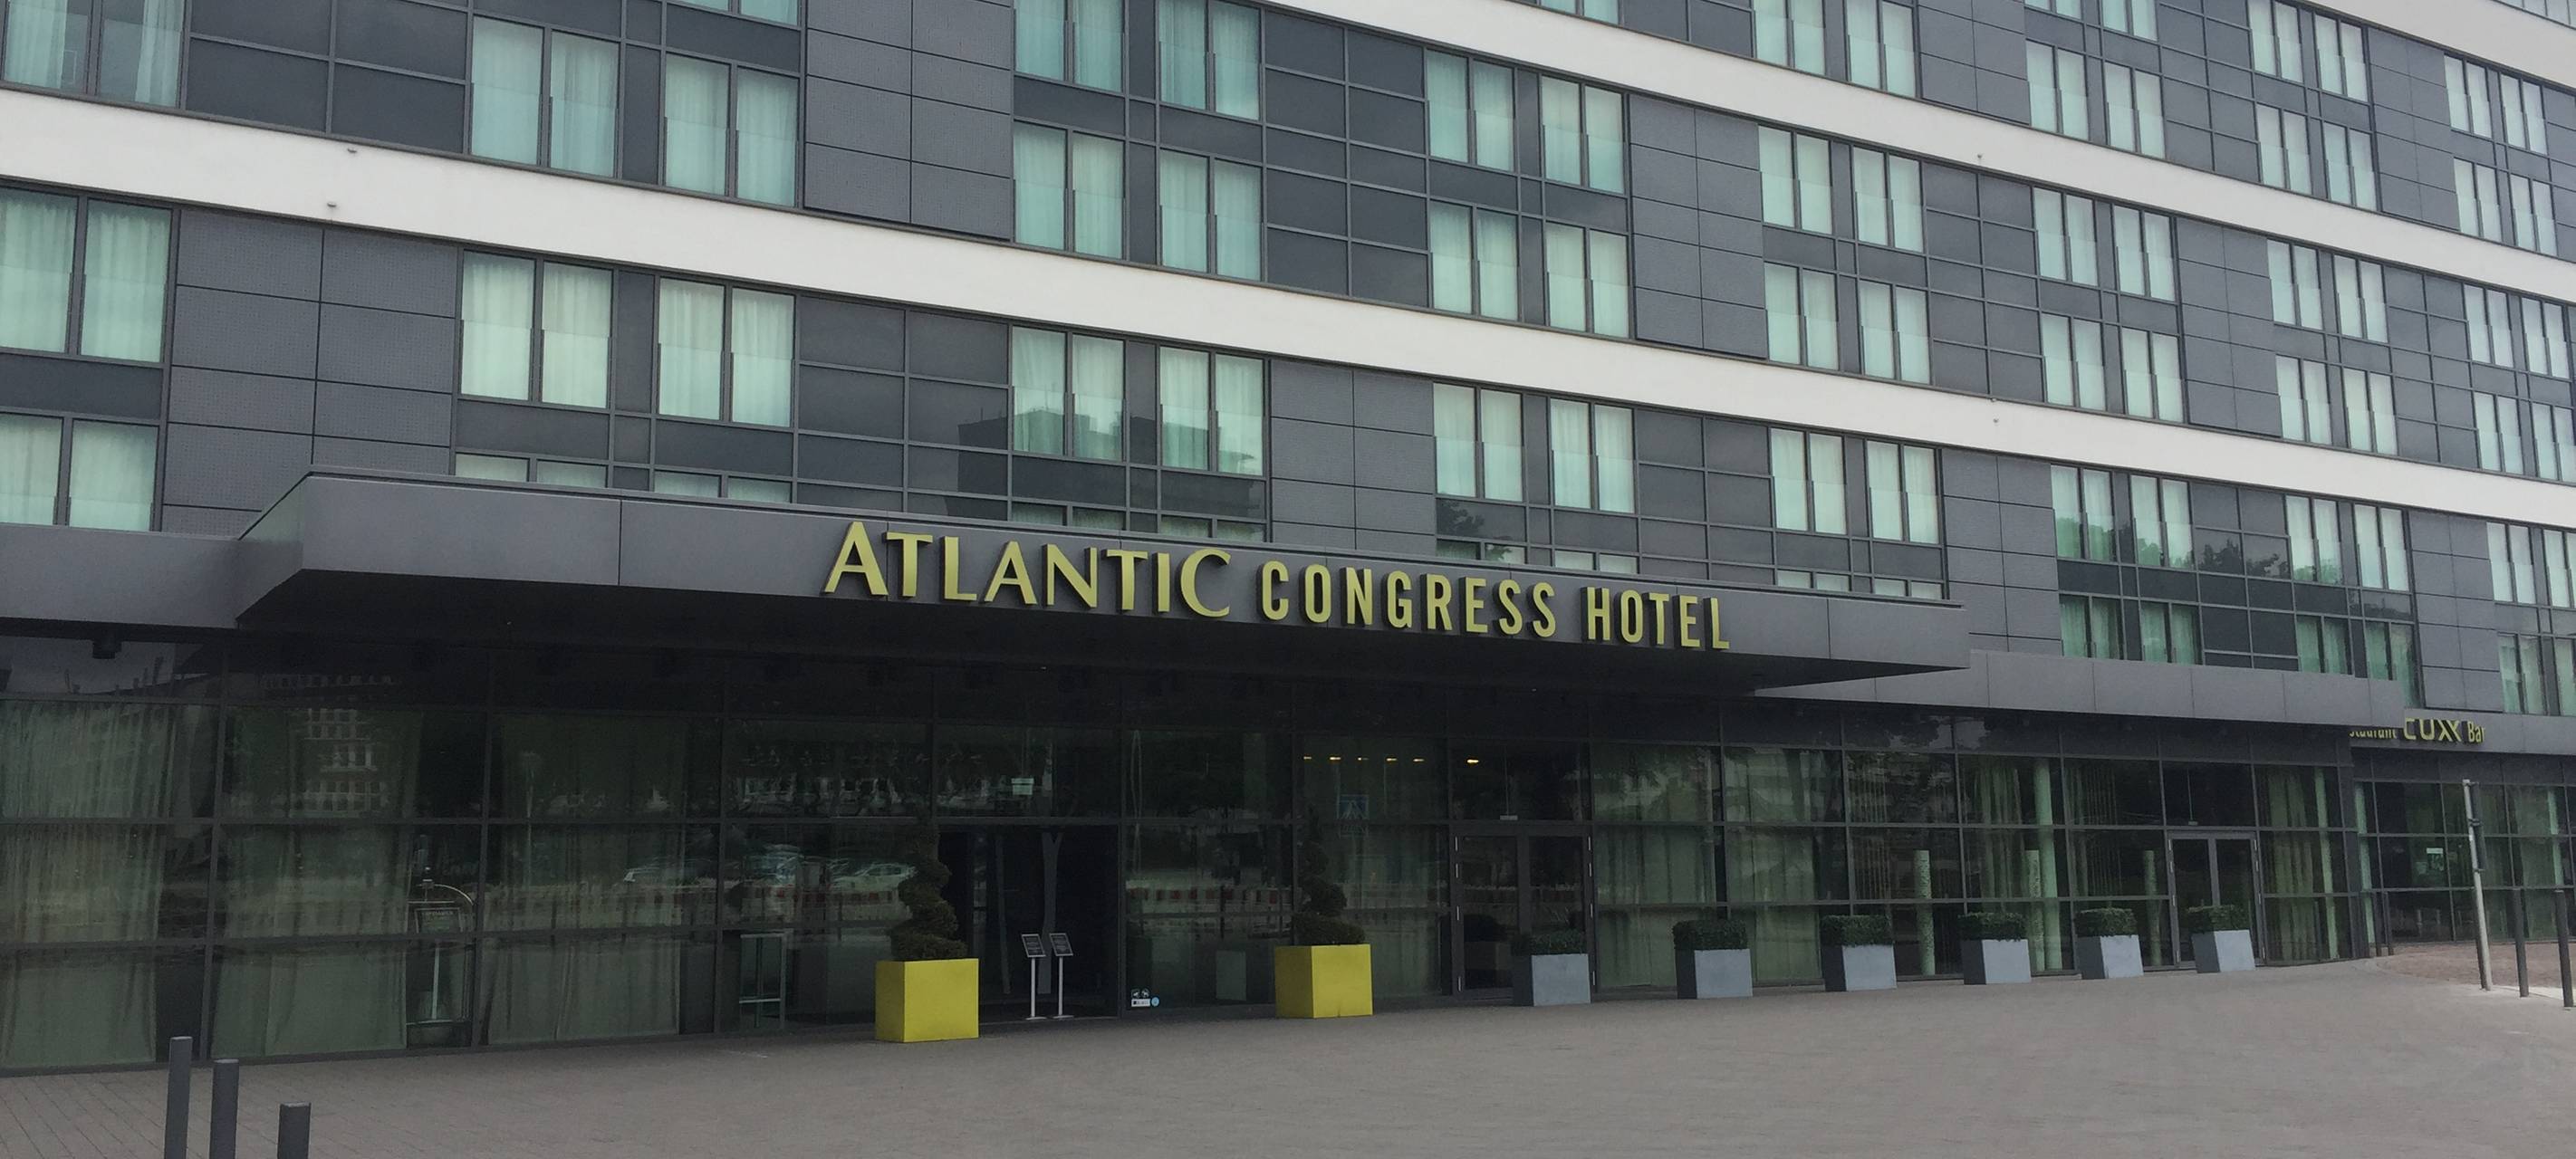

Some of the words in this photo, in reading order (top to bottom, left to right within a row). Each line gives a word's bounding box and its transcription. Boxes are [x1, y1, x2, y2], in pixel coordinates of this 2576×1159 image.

[824, 521, 1231, 618] ATLANTIC
[1261, 560, 1557, 637] CONGRESS
[1587, 586, 1731, 649] HOTEL
[2467, 721, 2486, 743] Bar
